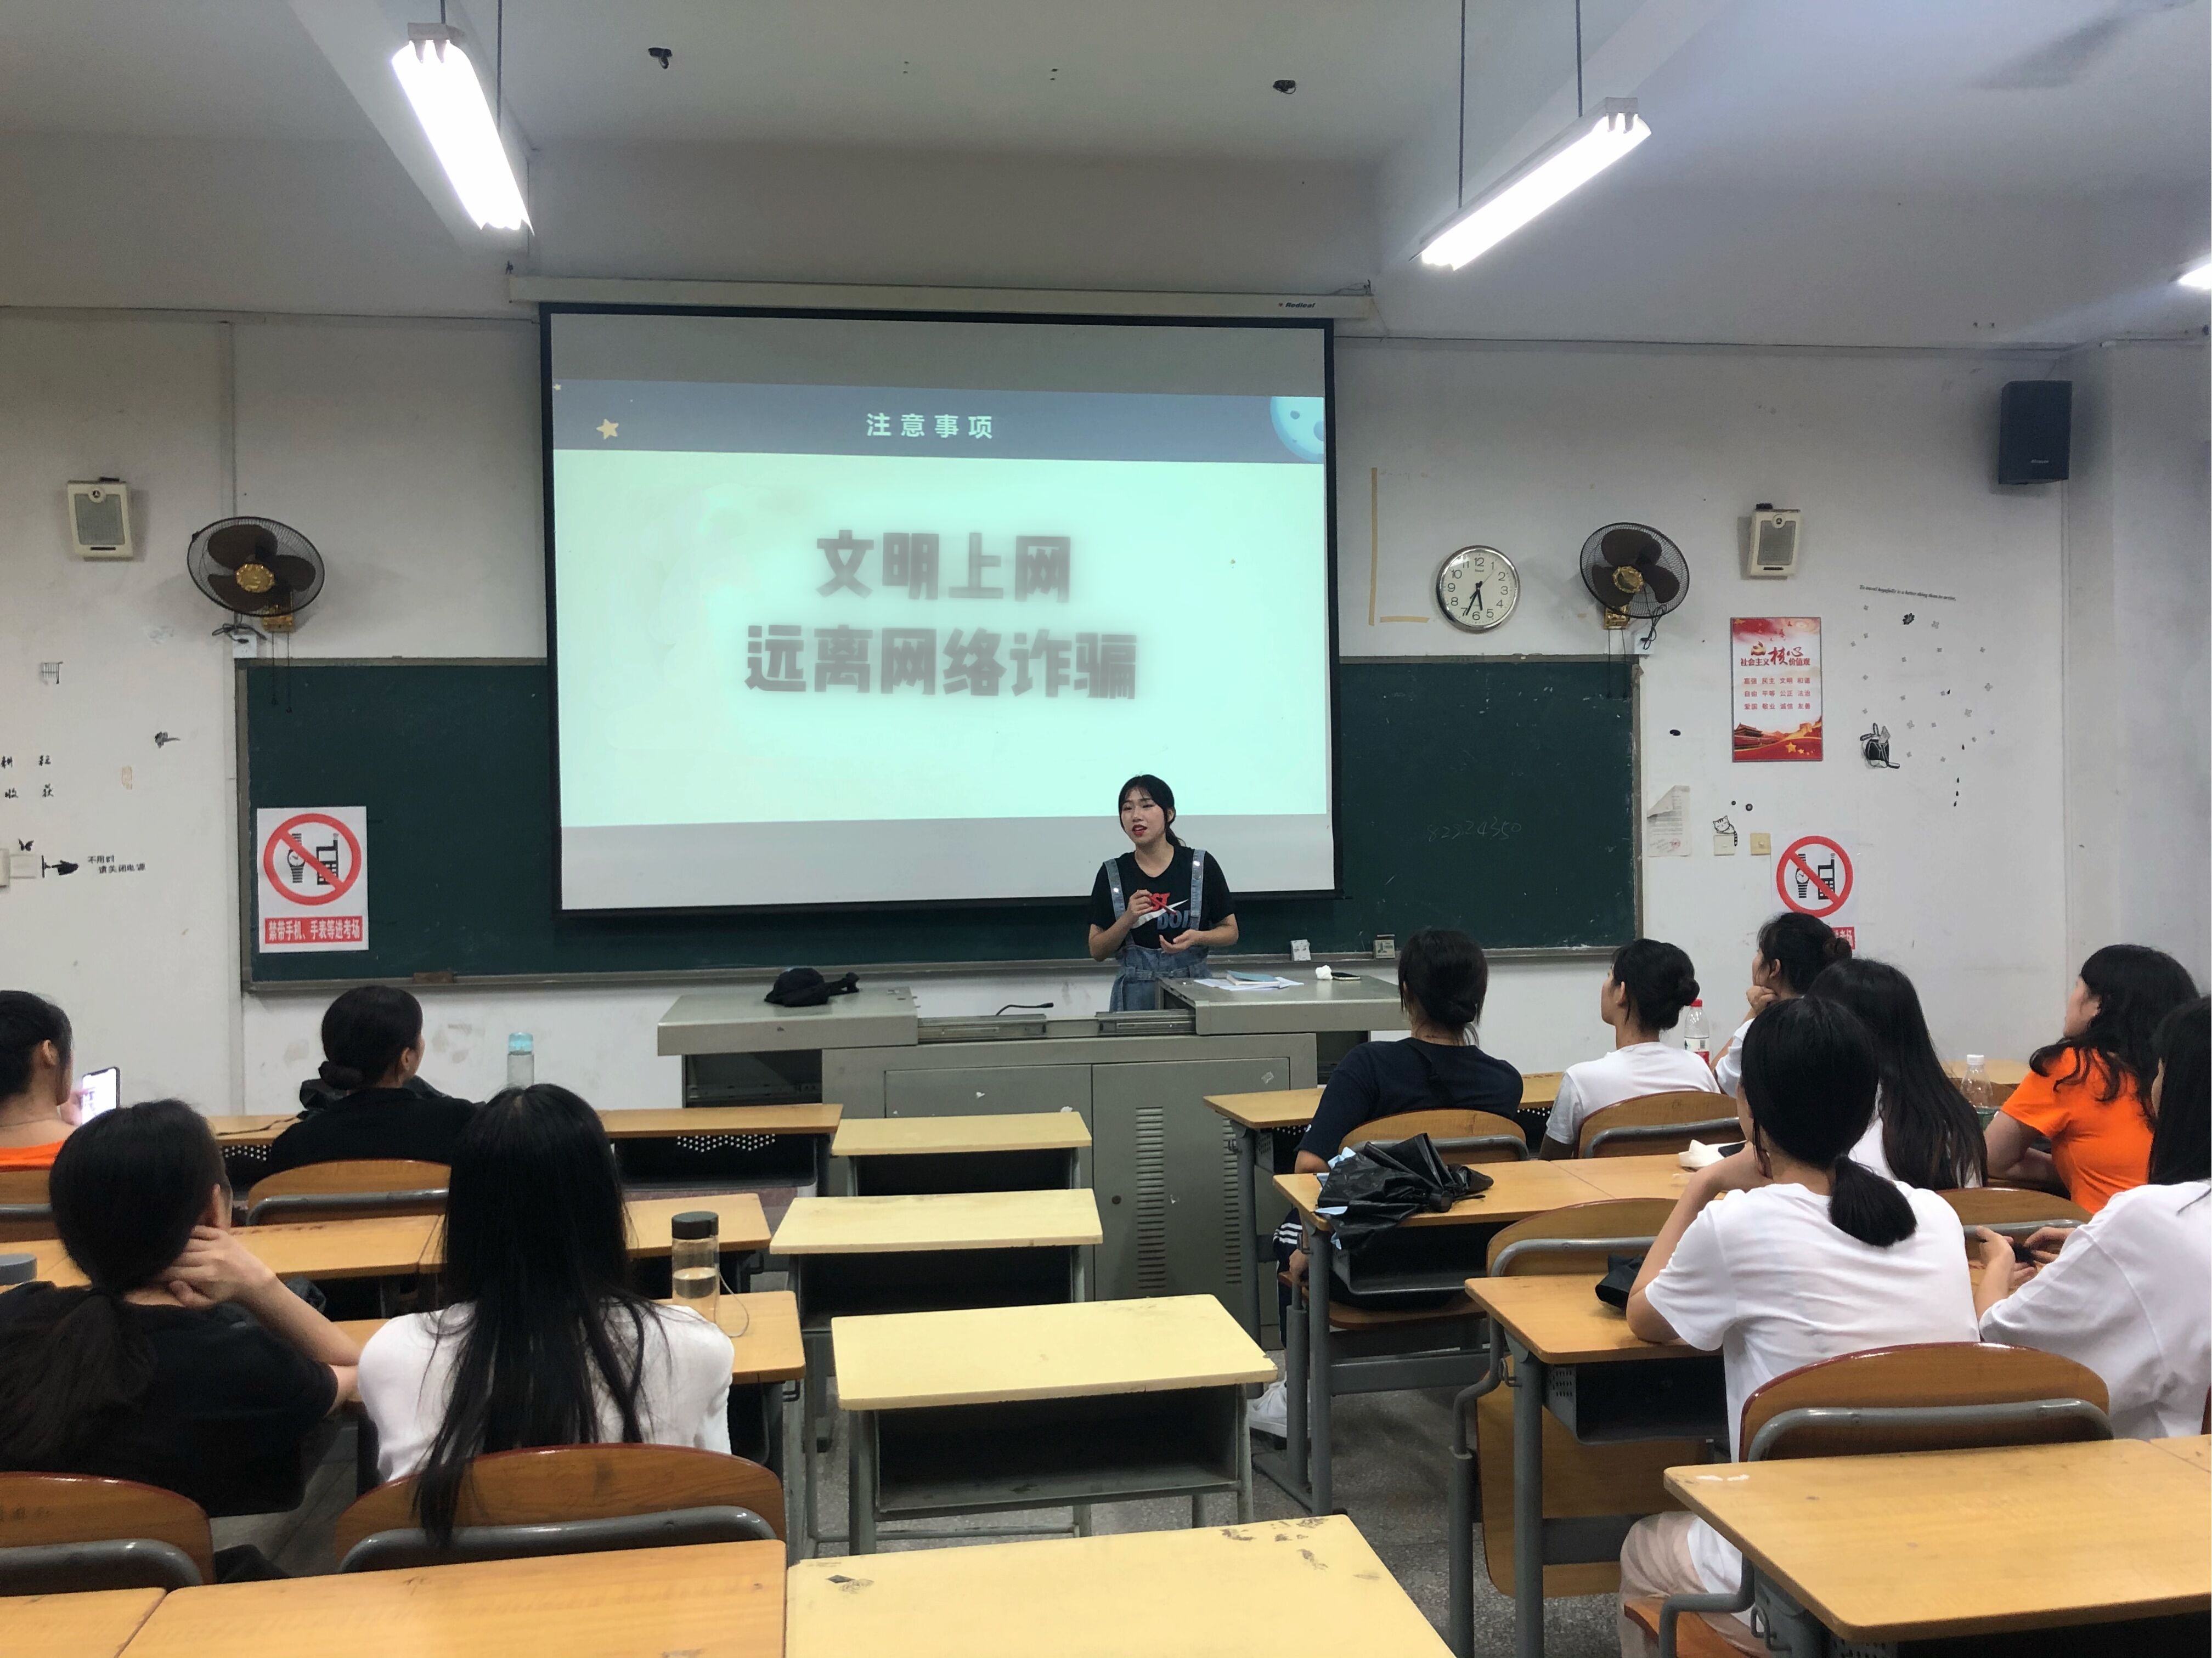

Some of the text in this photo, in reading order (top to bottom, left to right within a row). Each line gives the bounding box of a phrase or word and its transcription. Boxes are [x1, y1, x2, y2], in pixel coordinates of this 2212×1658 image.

[866, 412, 992, 439] 注意事项
[815, 529, 1071, 603] 文明上网
[1474, 557, 1485, 567] 12
[1452, 569, 1462, 579] 10
[1498, 571, 1506, 581] 2
[1448, 583, 1456, 592] 9
[1500, 586, 1508, 595] 3
[1451, 597, 1458, 606] 8
[1496, 600, 1503, 608] 4
[1472, 610, 1480, 620] 6
[1487, 609, 1494, 618] 5
[744, 624, 1137, 699] 远离网络诈骗
[269, 919, 360, 941] 禁带手机、手表等进考场
